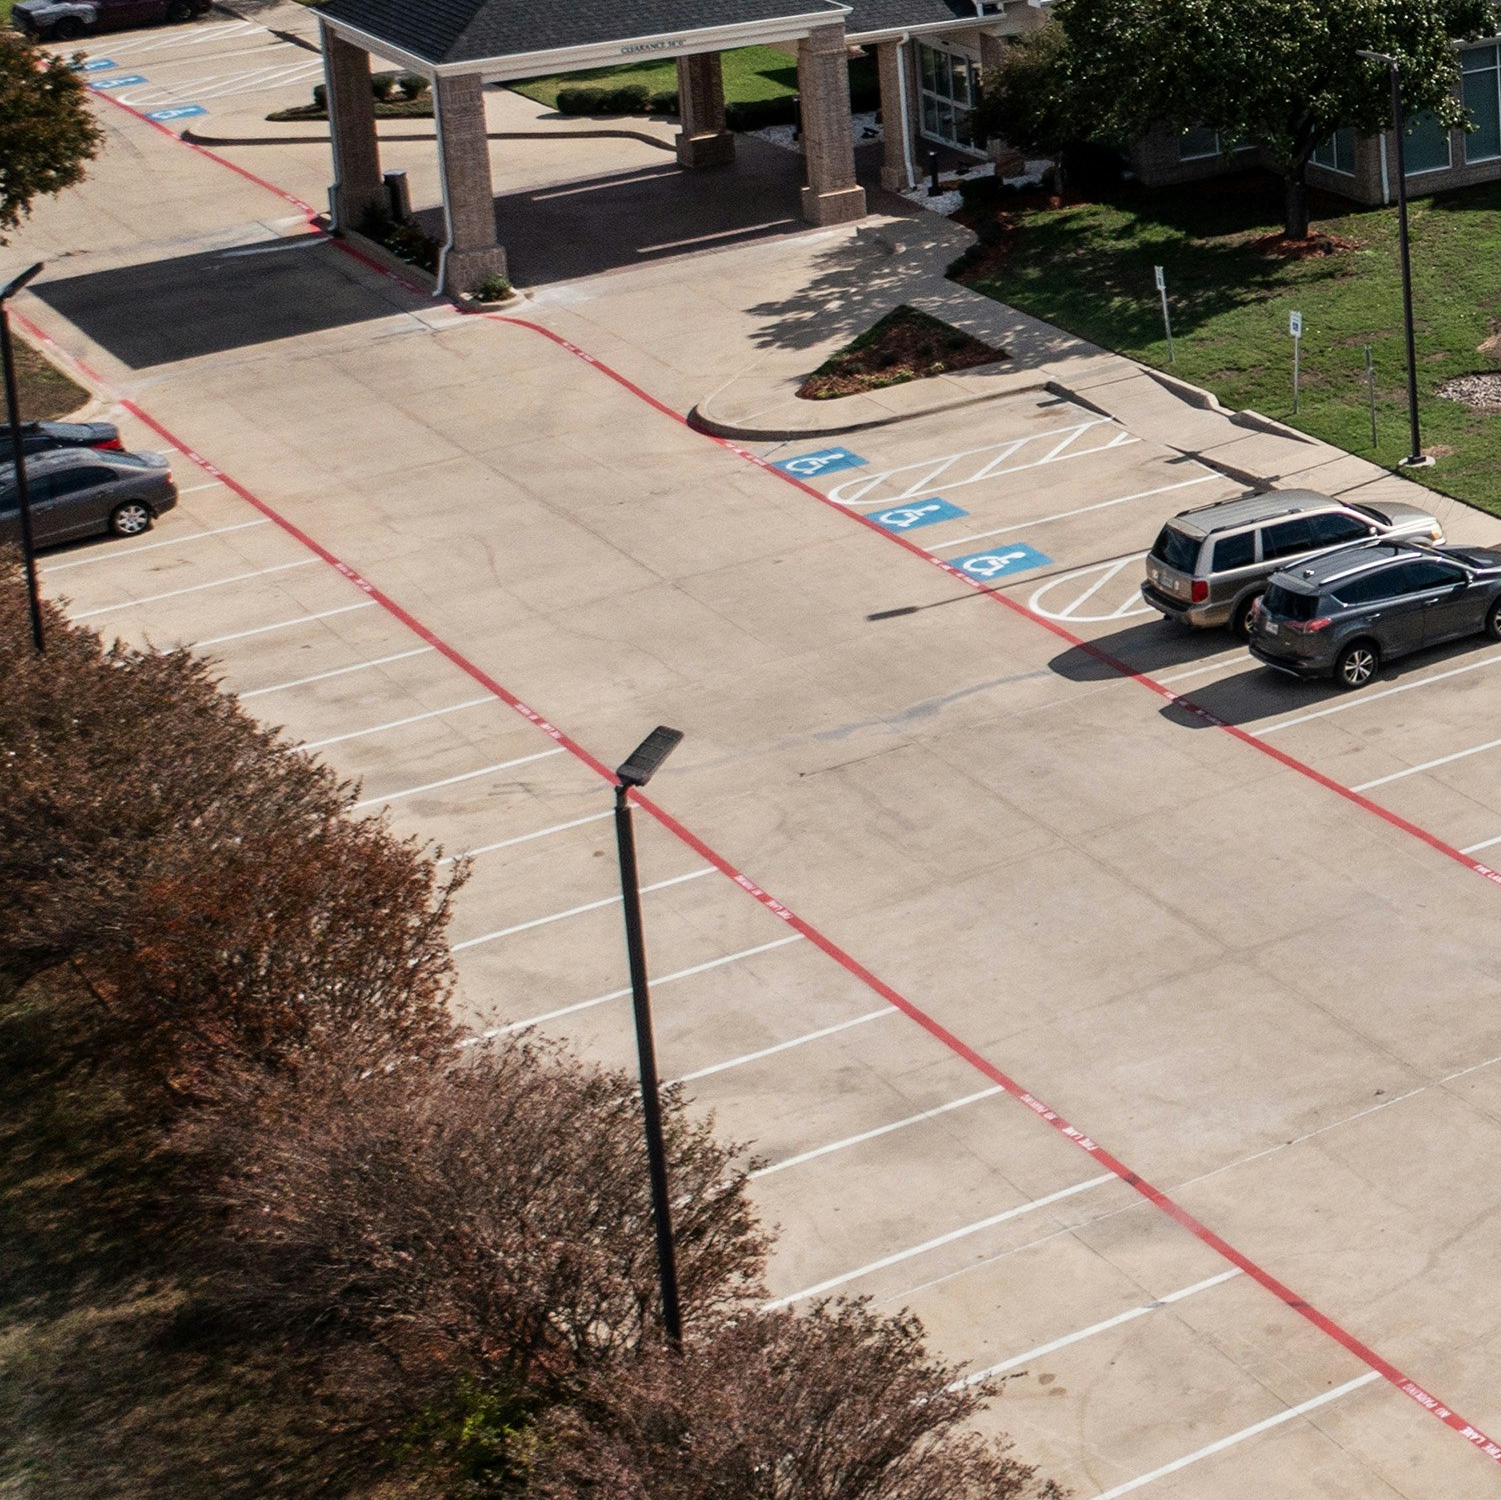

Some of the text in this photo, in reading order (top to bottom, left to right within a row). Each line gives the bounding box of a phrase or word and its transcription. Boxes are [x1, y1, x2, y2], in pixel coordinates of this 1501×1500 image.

[1402, 1382, 1439, 1409] PARKING
[1435, 1407, 1452, 1418] NO
[1459, 1425, 1487, 1444] LANE
